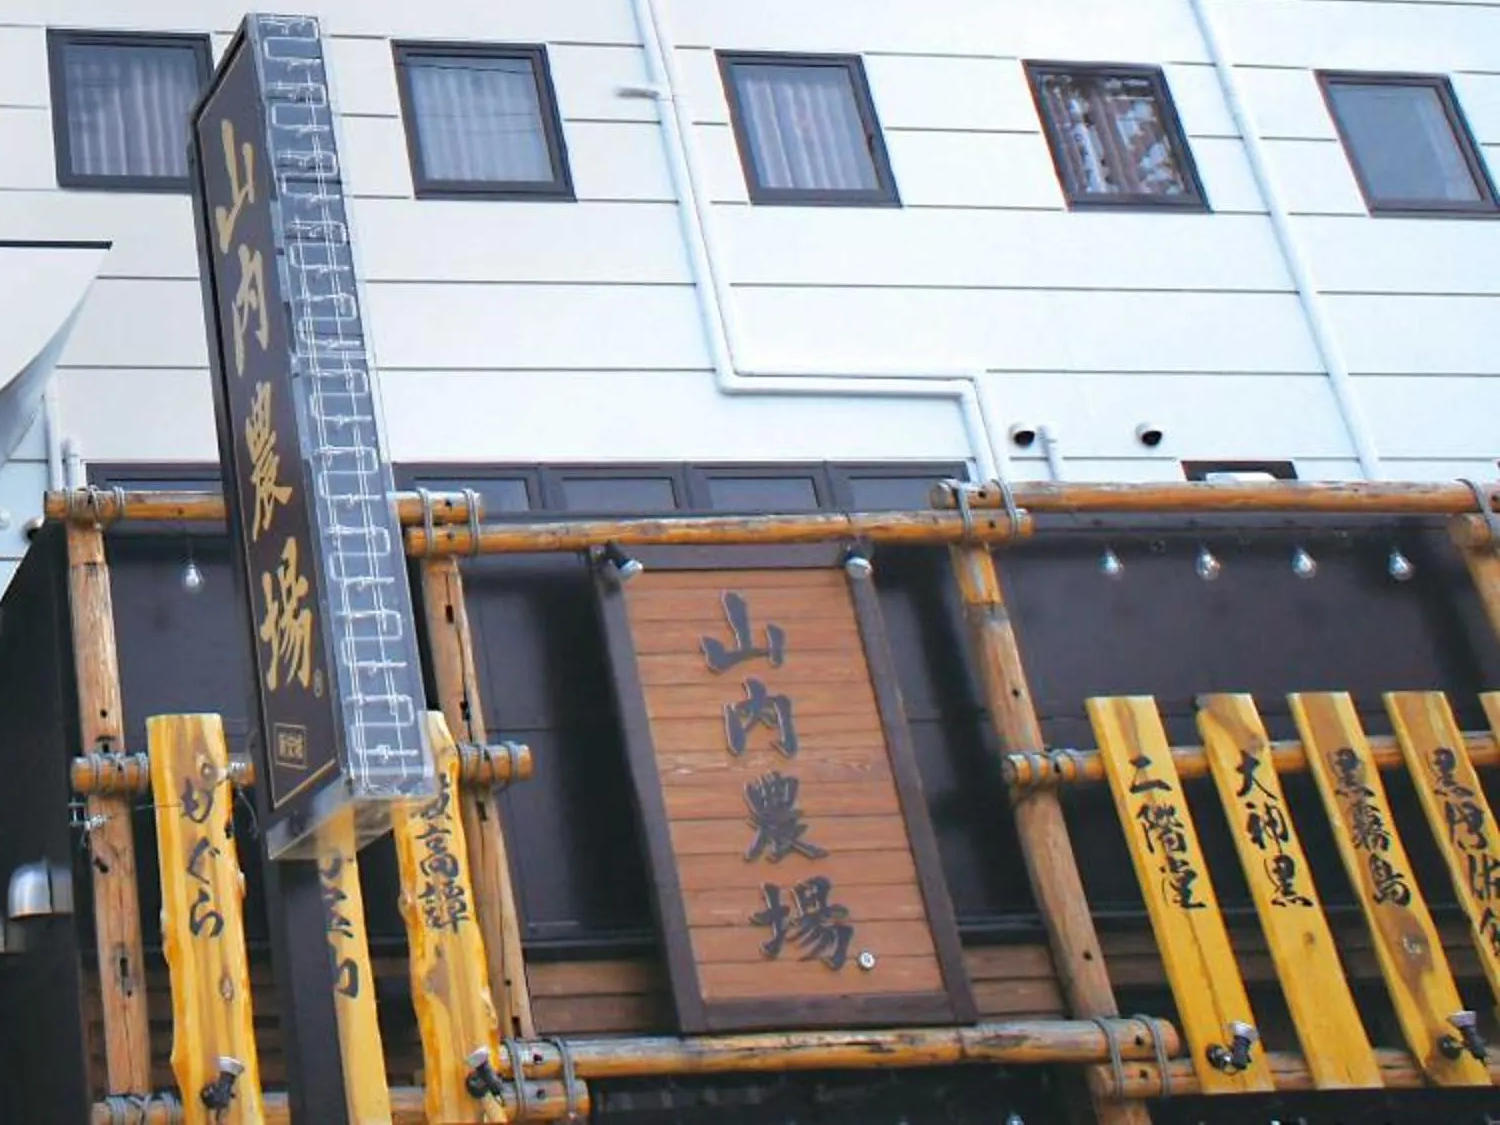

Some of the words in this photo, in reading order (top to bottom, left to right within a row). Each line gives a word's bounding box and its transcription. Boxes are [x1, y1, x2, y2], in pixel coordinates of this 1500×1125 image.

[216, 118, 313, 692] 山内農場
[701, 589, 855, 971] 山内農場
[1129, 755, 1207, 910] 二階堂
